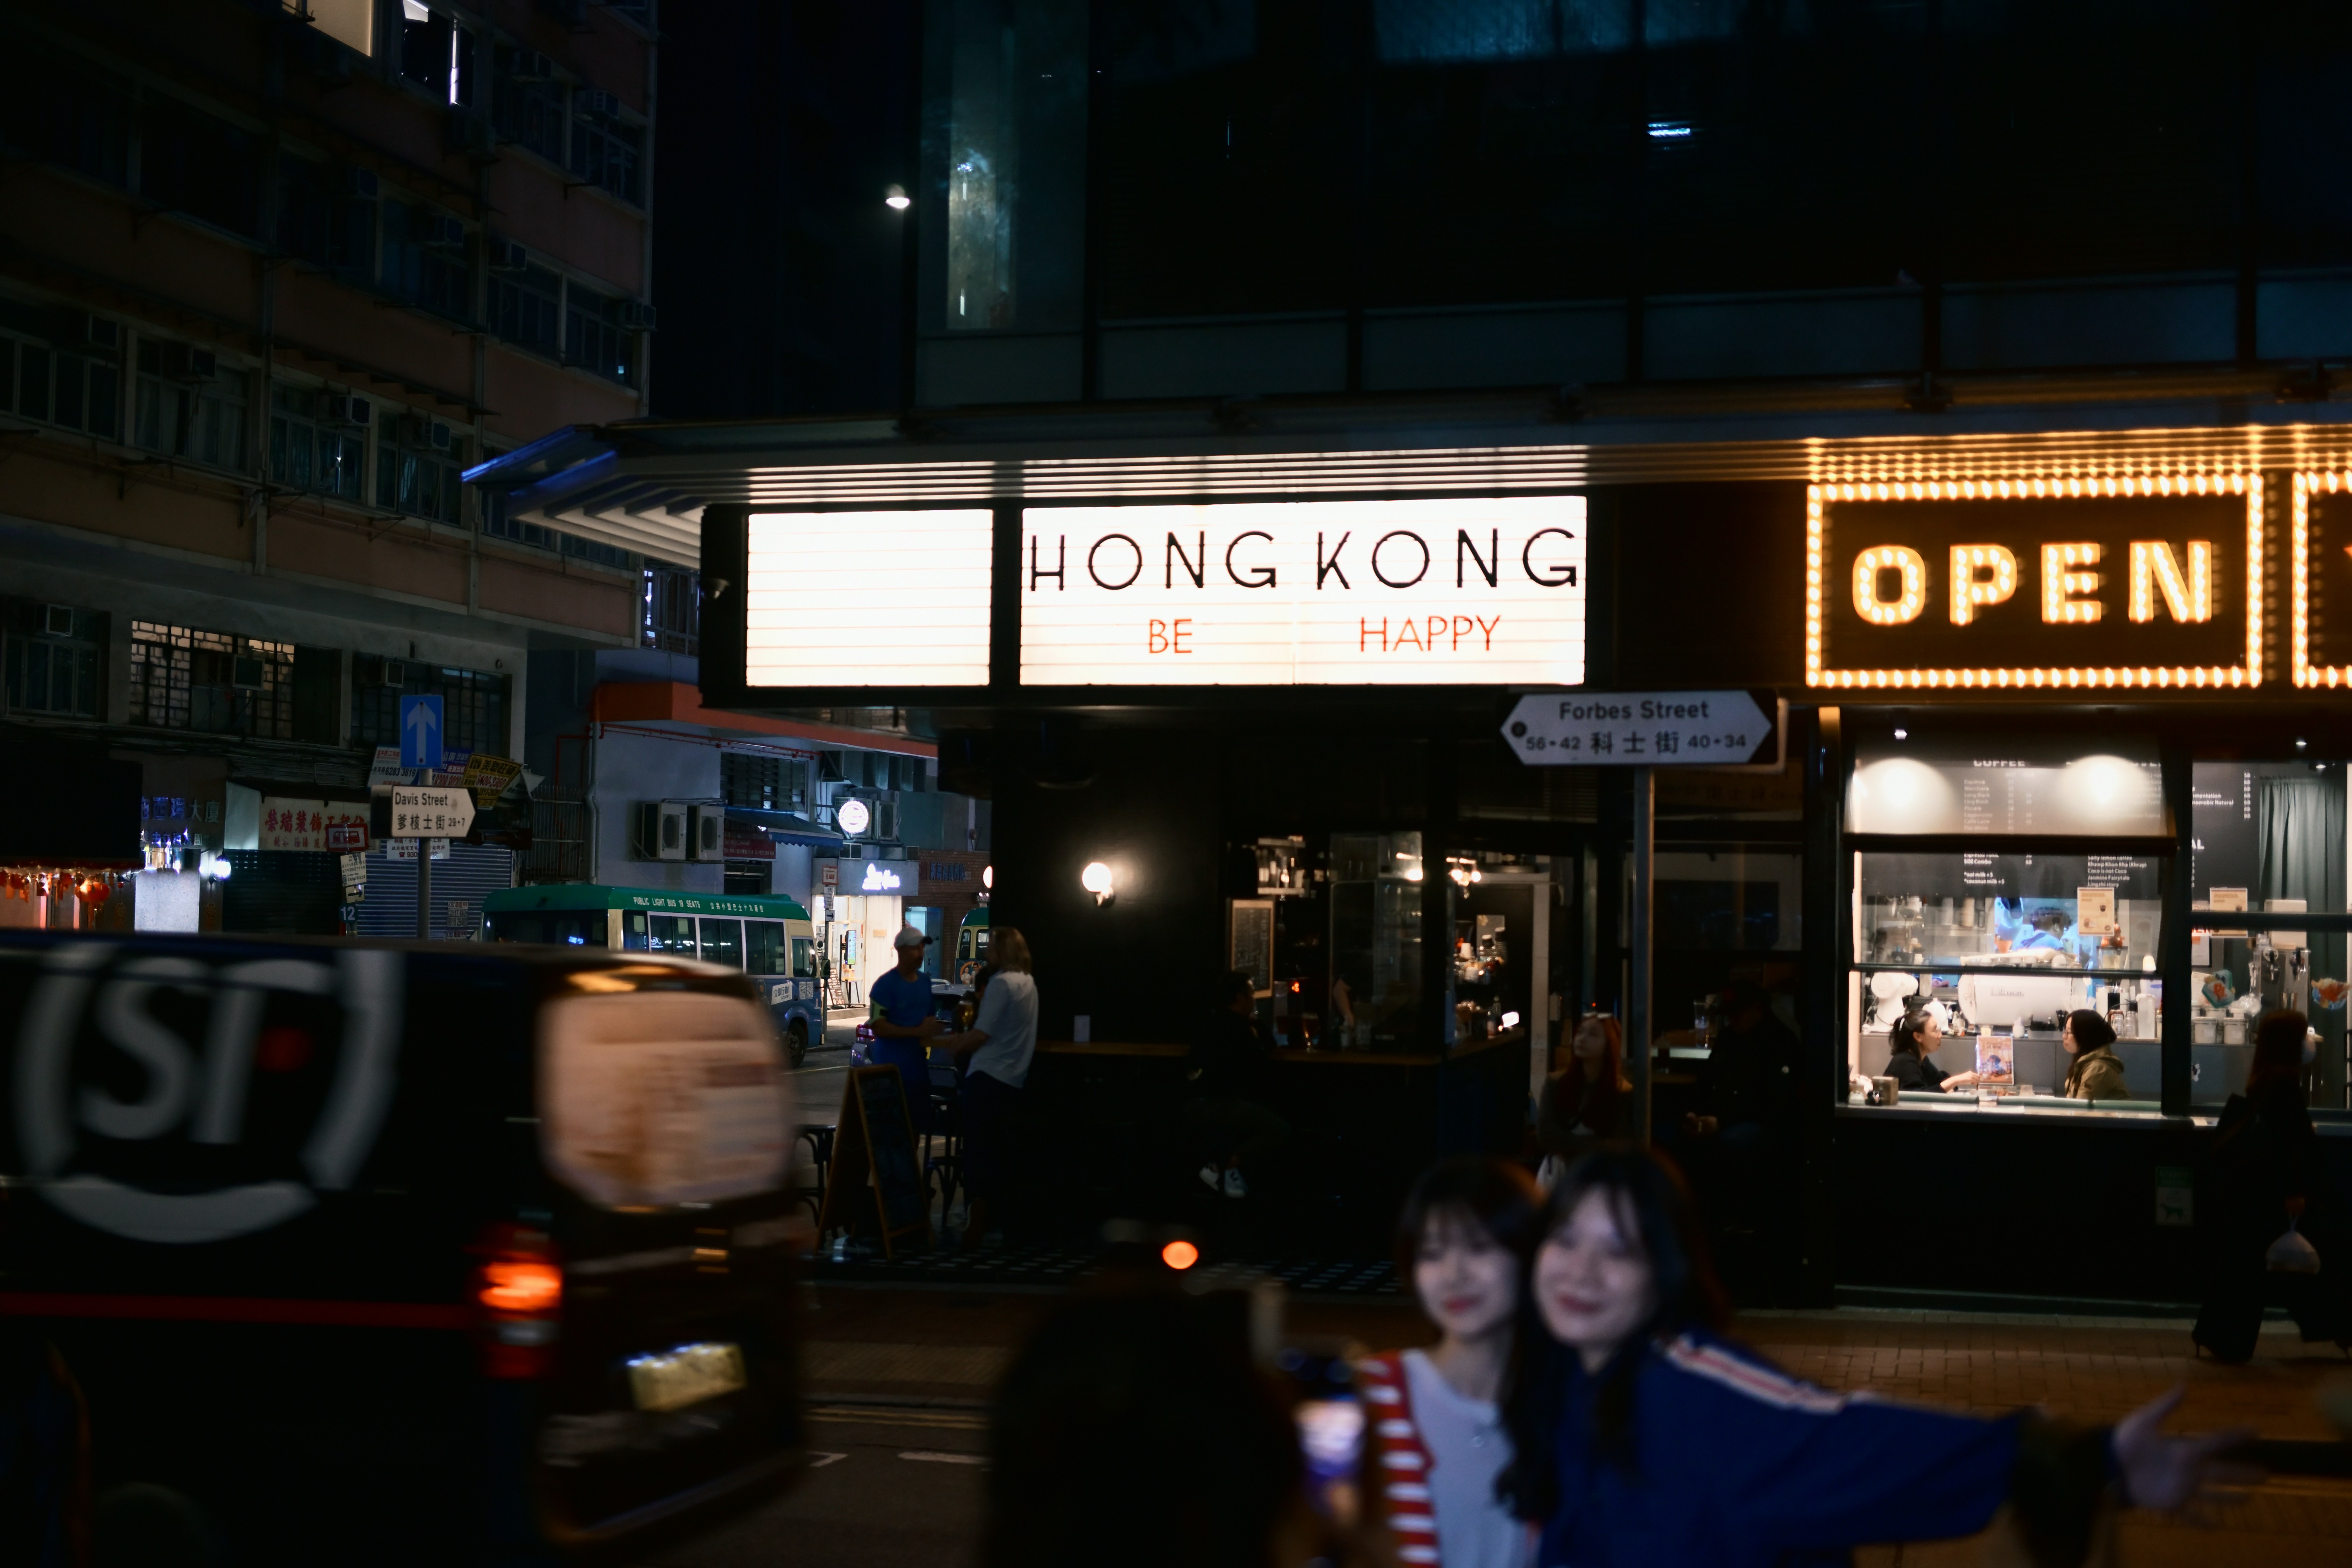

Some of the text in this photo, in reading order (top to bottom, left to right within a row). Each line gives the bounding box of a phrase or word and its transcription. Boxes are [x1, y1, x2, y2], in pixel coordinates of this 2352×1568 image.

[1030, 528, 1578, 592] HONG KONG
[1852, 540, 2212, 626] OPEN
[1149, 614, 1502, 654] BE HAPPY
[1559, 700, 1708, 720] Forbes Street
[1590, 731, 1679, 754] 科士街
[385, 767, 400, 776] 6283
[401, 768, 416, 777] 3619
[395, 792, 448, 806] Davis Street
[633, 896, 650, 905] PUBLIC
[652, 898, 665, 906] LIGHT
[667, 899, 676, 907] BUS
[686, 900, 701, 908] SEATS
[341, 906, 355, 920] 12
